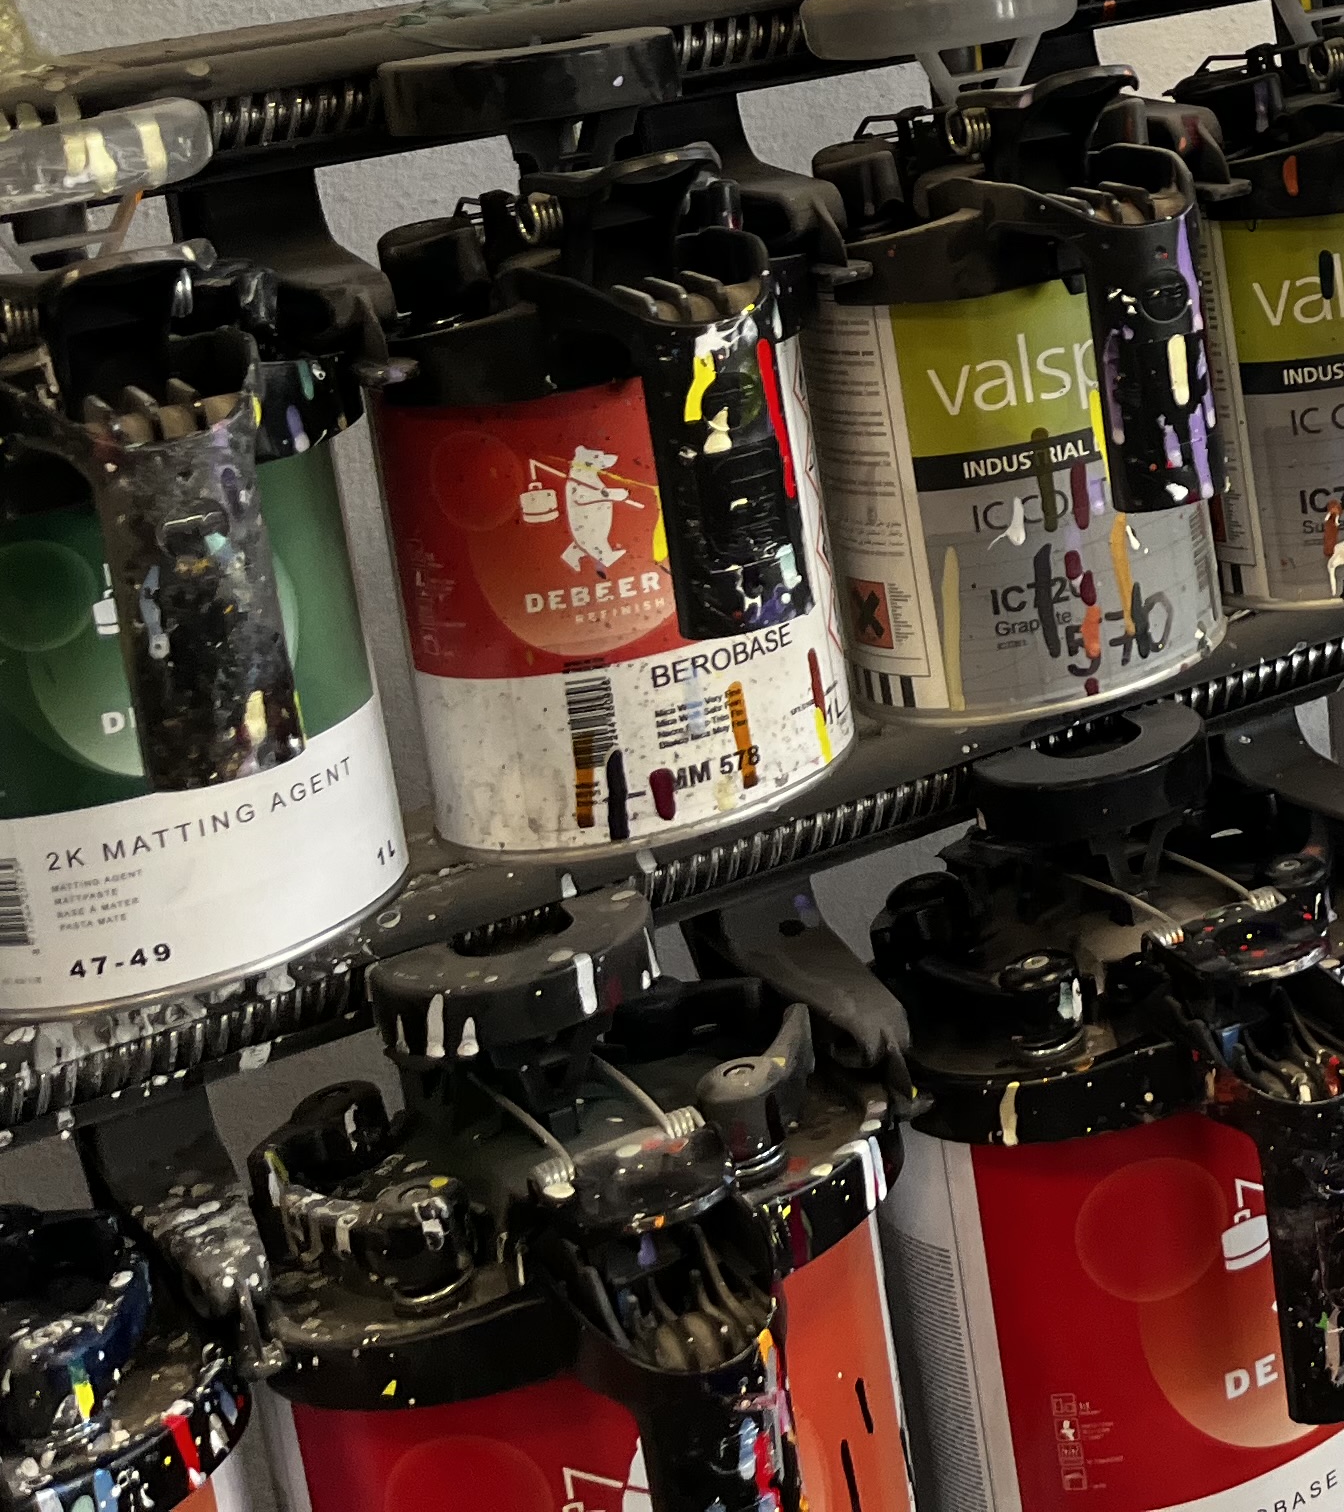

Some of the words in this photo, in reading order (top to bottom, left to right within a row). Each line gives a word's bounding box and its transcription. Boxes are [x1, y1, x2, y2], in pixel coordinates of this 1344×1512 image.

[927, 333, 1099, 418] valsp
[1290, 407, 1320, 437] IC
[963, 436, 1090, 480] INDUSIAL
[525, 570, 663, 614] DEBEER
[994, 608, 1072, 636] Grapte
[650, 622, 794, 689] BEROBASE
[719, 744, 761, 775] 578
[46, 845, 86, 872] 2K
[102, 801, 256, 863] MATTING
[270, 754, 353, 814] AGENT
[69, 941, 174, 979] 47-49
